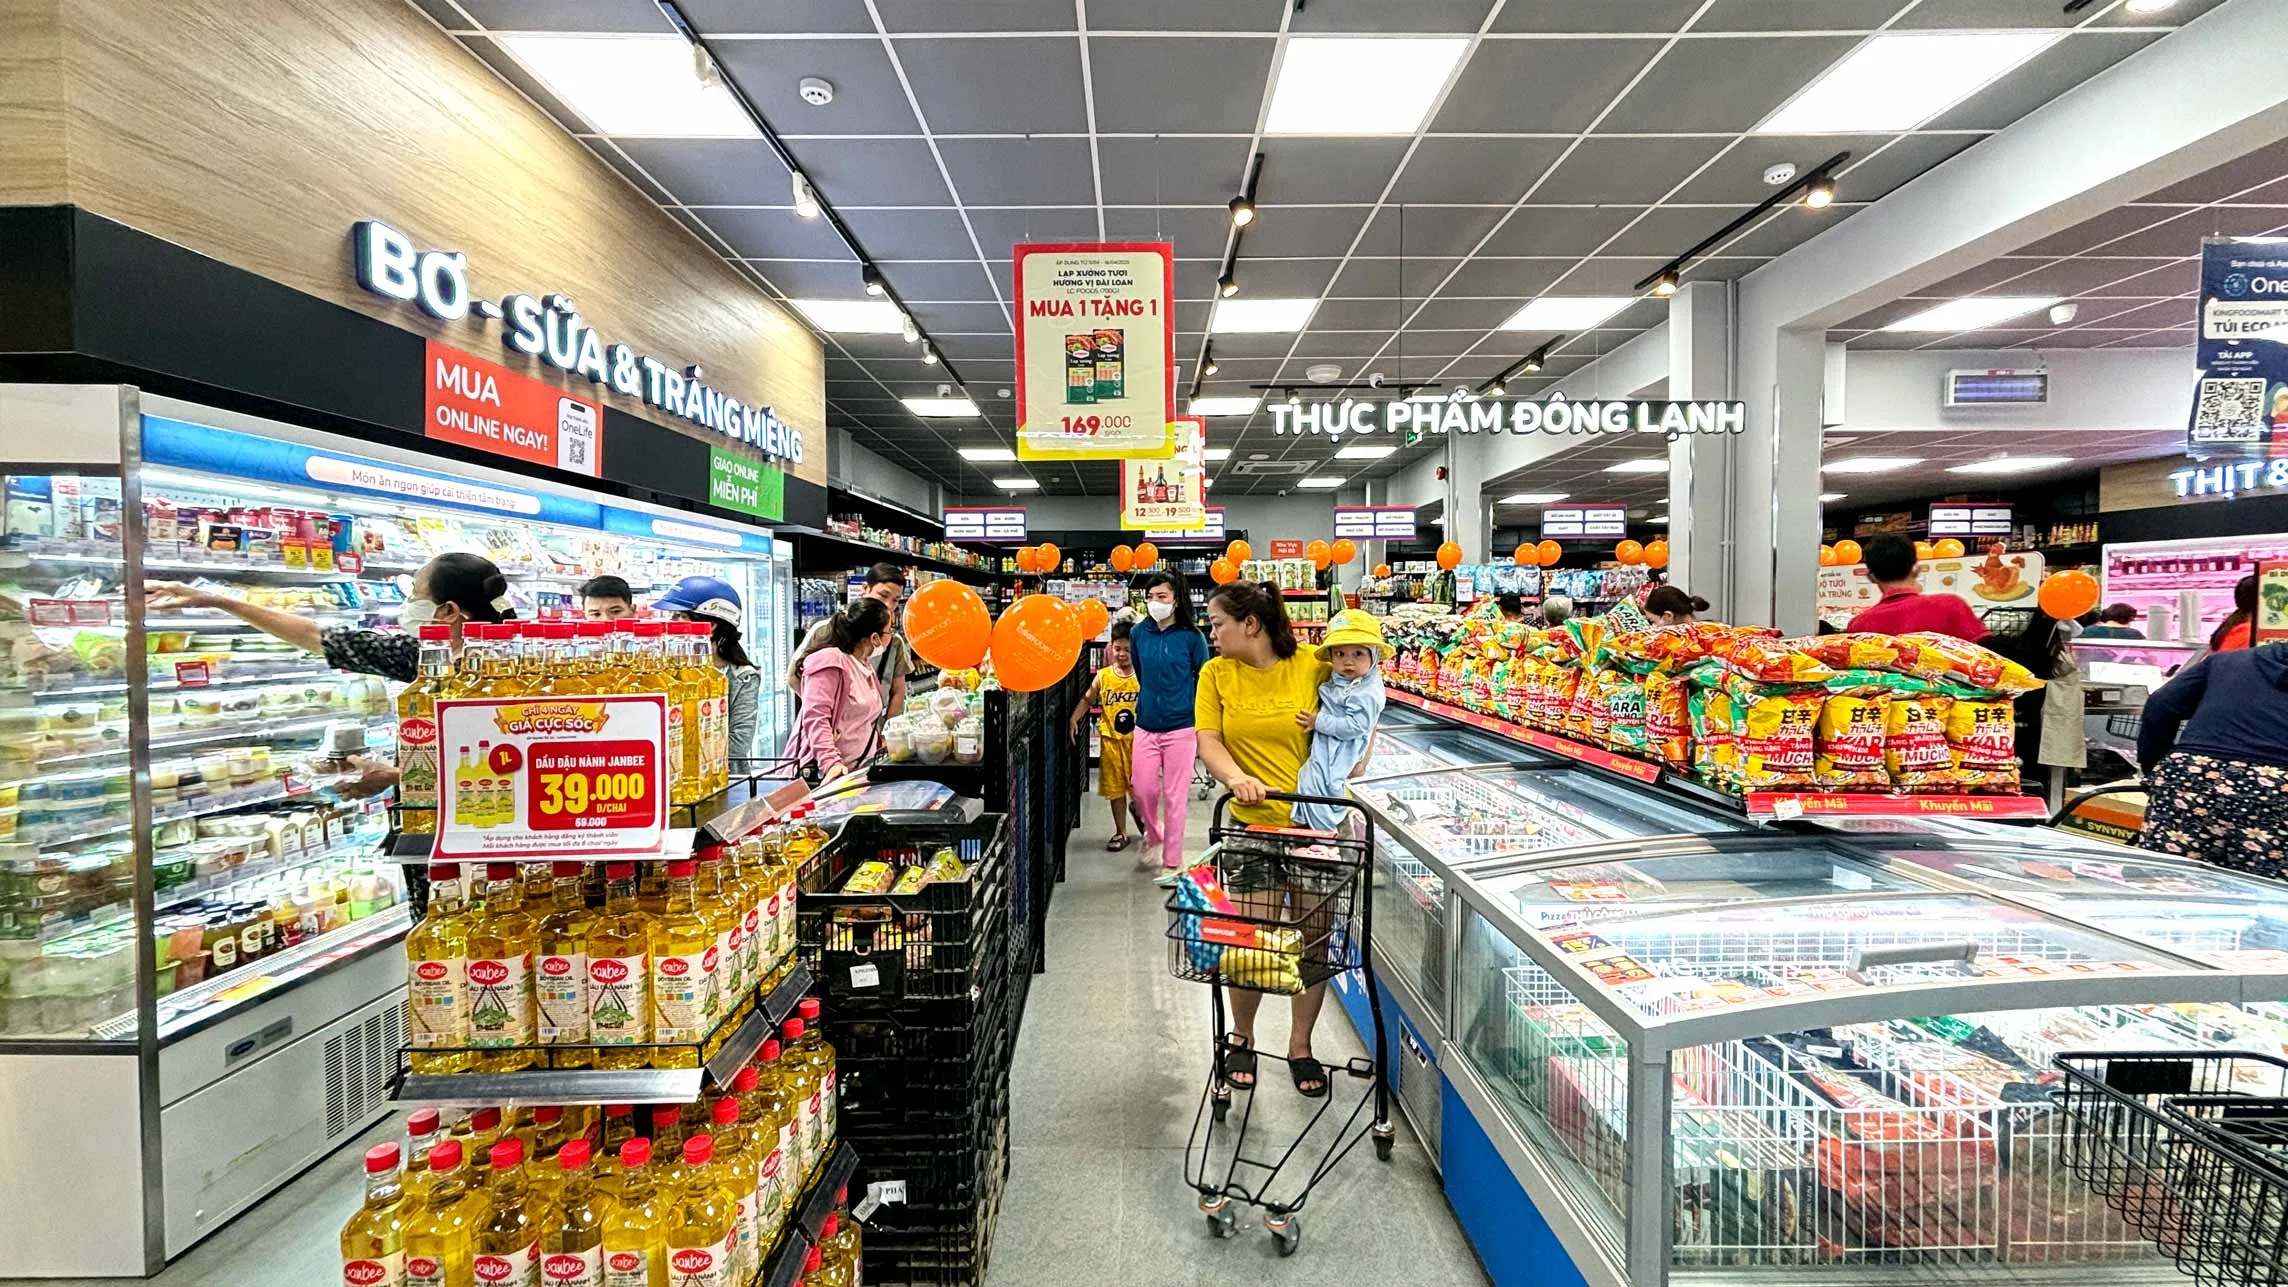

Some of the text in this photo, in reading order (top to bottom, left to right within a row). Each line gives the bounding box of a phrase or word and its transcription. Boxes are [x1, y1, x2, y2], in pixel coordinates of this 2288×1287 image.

[1085, 279, 1094, 287] VỊ
[1107, 269, 1128, 277] TƯƠI
[1030, 294, 1158, 321] MUA 1 TẶNG 1
[2214, 319, 2271, 333] TÚI ECO
[362, 219, 469, 322] BƠ
[509, 292, 607, 384] SỮA
[612, 343, 641, 397] &
[642, 363, 741, 438] TRÁNG
[742, 403, 804, 465] MIỆNG
[436, 357, 501, 408] MUA
[1266, 386, 1746, 443] THỰC PHẨM ĐÔNG LẠNH
[436, 405, 548, 452] ONLINE NGAY!
[561, 419, 593, 439] OneLife
[714, 455, 760, 483] GIAO ONLINE
[352, 468, 376, 485] Món
[378, 474, 391, 487] ăn
[393, 481, 418, 492] ngon
[2169, 461, 2265, 500] THỊT
[713, 475, 759, 508] MIỄN PHÍ
[509, 716, 593, 734] GIÁ CỰC SỐC
[499, 750, 513, 767] 1L
[535, 754, 646, 772] DẦU ĐẬU NÀNH JANBEE
[540, 773, 645, 815] 39.000
[1824, 797, 1847, 809] Mãi
[1920, 799, 1994, 813] Khuyến Mãi
[470, 963, 508, 982] Janbee
[591, 962, 628, 980] Janbee
